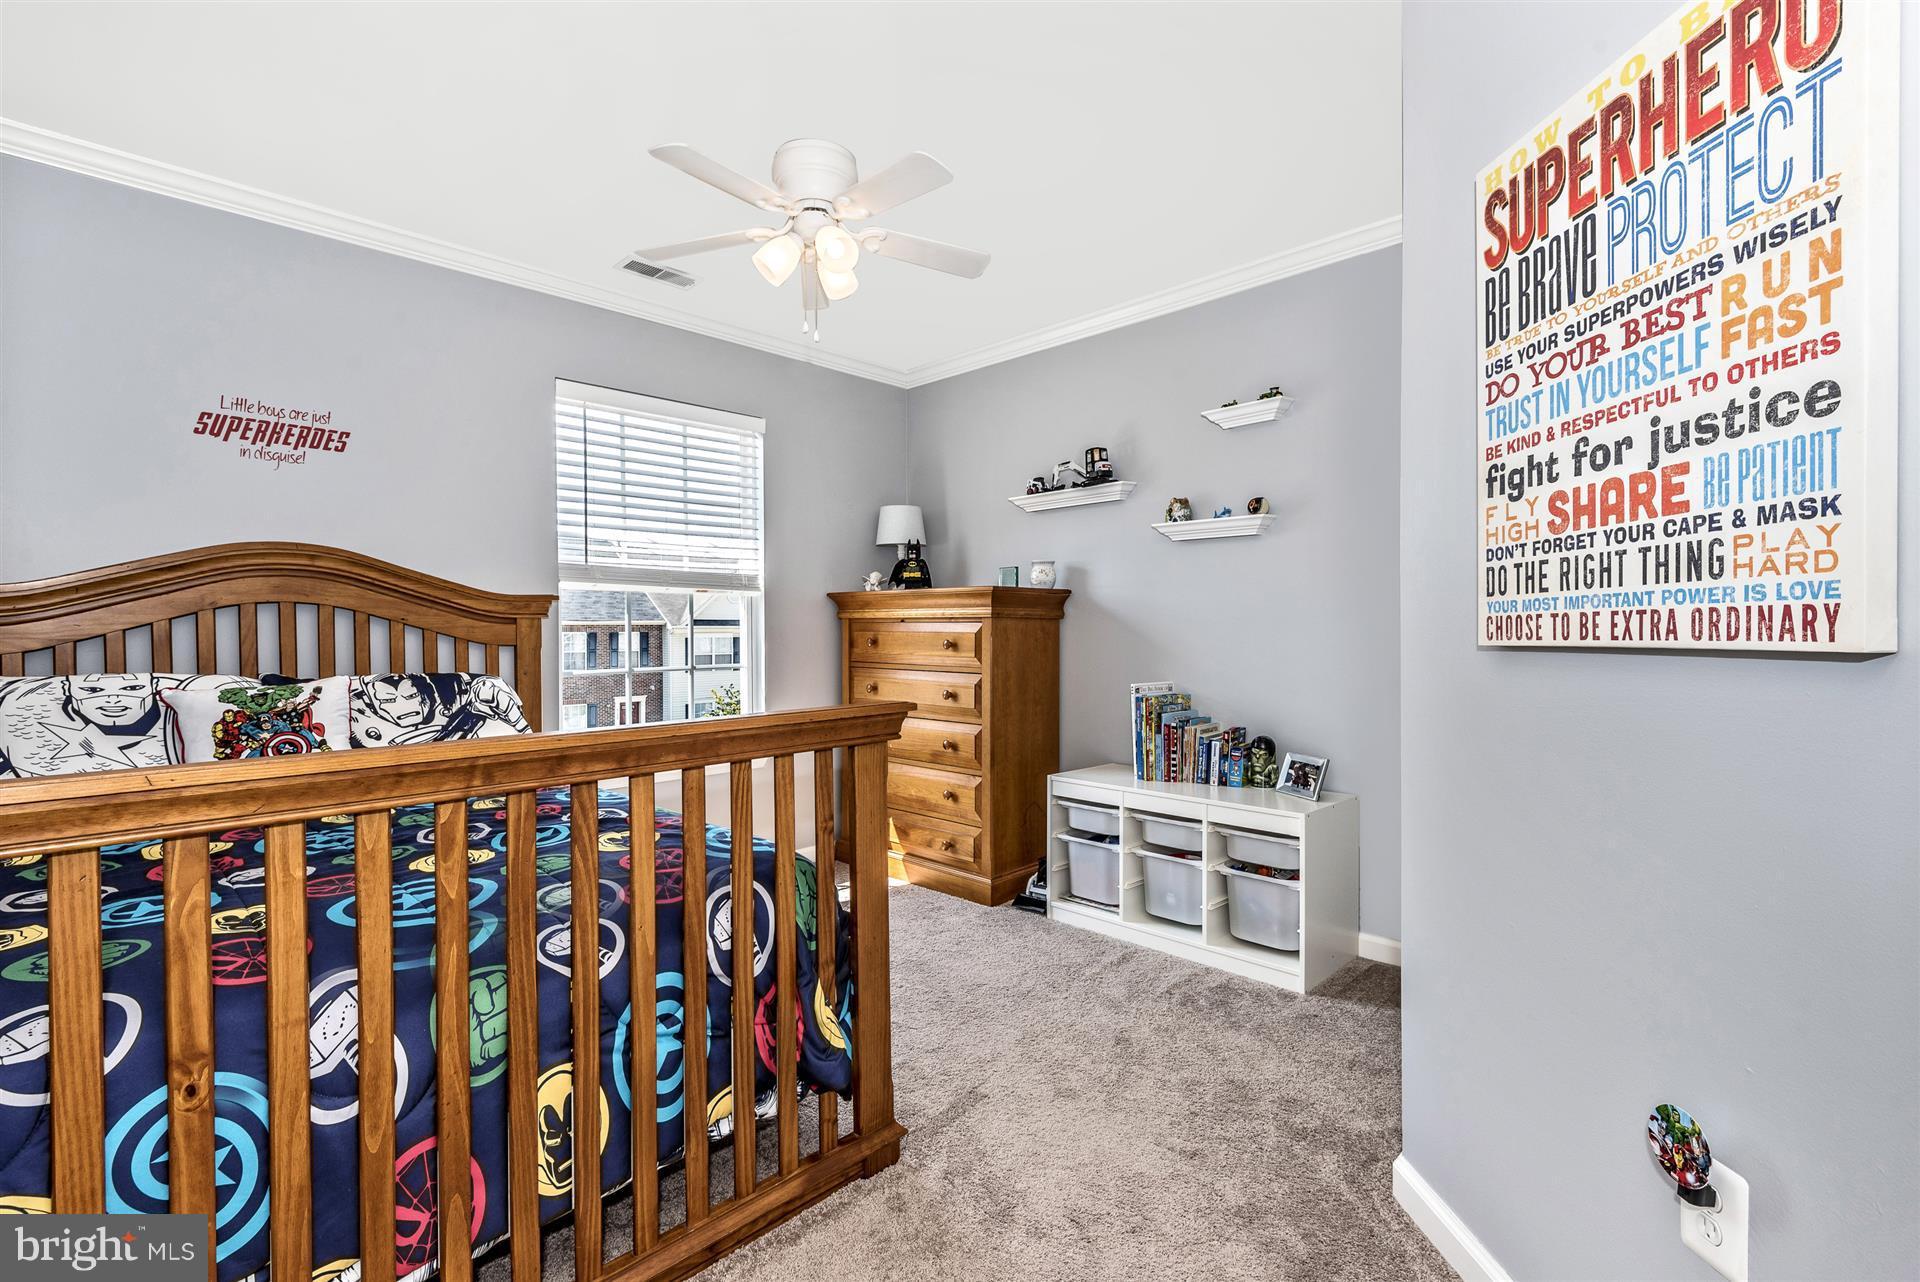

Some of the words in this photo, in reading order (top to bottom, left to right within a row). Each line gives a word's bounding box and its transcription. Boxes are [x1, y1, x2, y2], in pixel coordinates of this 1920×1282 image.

[1483, 0, 1843, 270] SUPERHERO
[1484, 117, 1562, 195] HOW
[1587, 54, 1646, 111] TO
[1607, 57, 1842, 287] PROTECT
[1485, 353, 1513, 379] USE
[1517, 333, 1559, 365] YOUR
[1564, 253, 1724, 344] SUPERPOWERS
[1733, 195, 1842, 265] WISELY
[1486, 346, 1500, 360] BE
[1505, 324, 1542, 348] TRUE
[1547, 312, 1567, 330] TO
[1573, 261, 1667, 317] YOURSELF
[1671, 236, 1719, 269] AND
[1727, 172, 1842, 240] OTHERS
[1721, 227, 1842, 318] RUN
[1485, 373, 1520, 406] DO
[1527, 333, 1610, 388] YOUR
[1620, 284, 1713, 350] BEST
[1721, 275, 1843, 360] FAST
[220, 394, 255, 414] Little
[257, 400, 286, 423] boys
[288, 407, 309, 422] are
[311, 410, 331, 427] just
[1485, 389, 1543, 441] TRUST
[1550, 378, 1570, 420] IN
[1577, 322, 1711, 408] YOURSELF
[1485, 444, 1502, 462] BE
[1507, 431, 1541, 455] KIND
[1546, 426, 1555, 442] &
[1560, 385, 1681, 438] RESPECTFUL
[1688, 371, 1718, 397] TO
[1727, 331, 1841, 385] OTHERS
[193, 411, 351, 453] SUPERHEROES
[239, 444, 251, 458] in
[254, 446, 306, 471] disguise!
[1485, 451, 1559, 502] fight
[1572, 435, 1633, 477] for
[1648, 379, 1842, 470] justice
[1485, 496, 1539, 526] FLY
[1485, 519, 1539, 546] HIGH
[1533, 532, 1596, 556] FORGET
[1603, 523, 1655, 546] YOUR
[1663, 512, 1723, 538] CAPE
[1732, 508, 1746, 528] &
[1757, 494, 1842, 526] MASK
[1547, 461, 1690, 535] SHARE
[1486, 565, 1507, 597] DO
[1513, 559, 1549, 595] THE
[1559, 549, 1627, 592] RIGHT
[1638, 538, 1724, 586] THING
[1733, 522, 1841, 556] PLAY
[1733, 549, 1839, 579] HARD
[1486, 613, 1543, 641] CHOOSE
[1550, 612, 1570, 641] TO
[1579, 611, 1600, 641] BE
[1610, 608, 1679, 641] EXTRA
[1690, 602, 1841, 643] ORDINARY
[1487, 600, 1518, 614] YOUR
[1522, 597, 1559, 612] MOST
[1564, 590, 1655, 610] IMPORTANT
[1662, 585, 1736, 606] POWER
[1744, 583, 1767, 602] IS
[1776, 579, 1841, 601] LOVE
